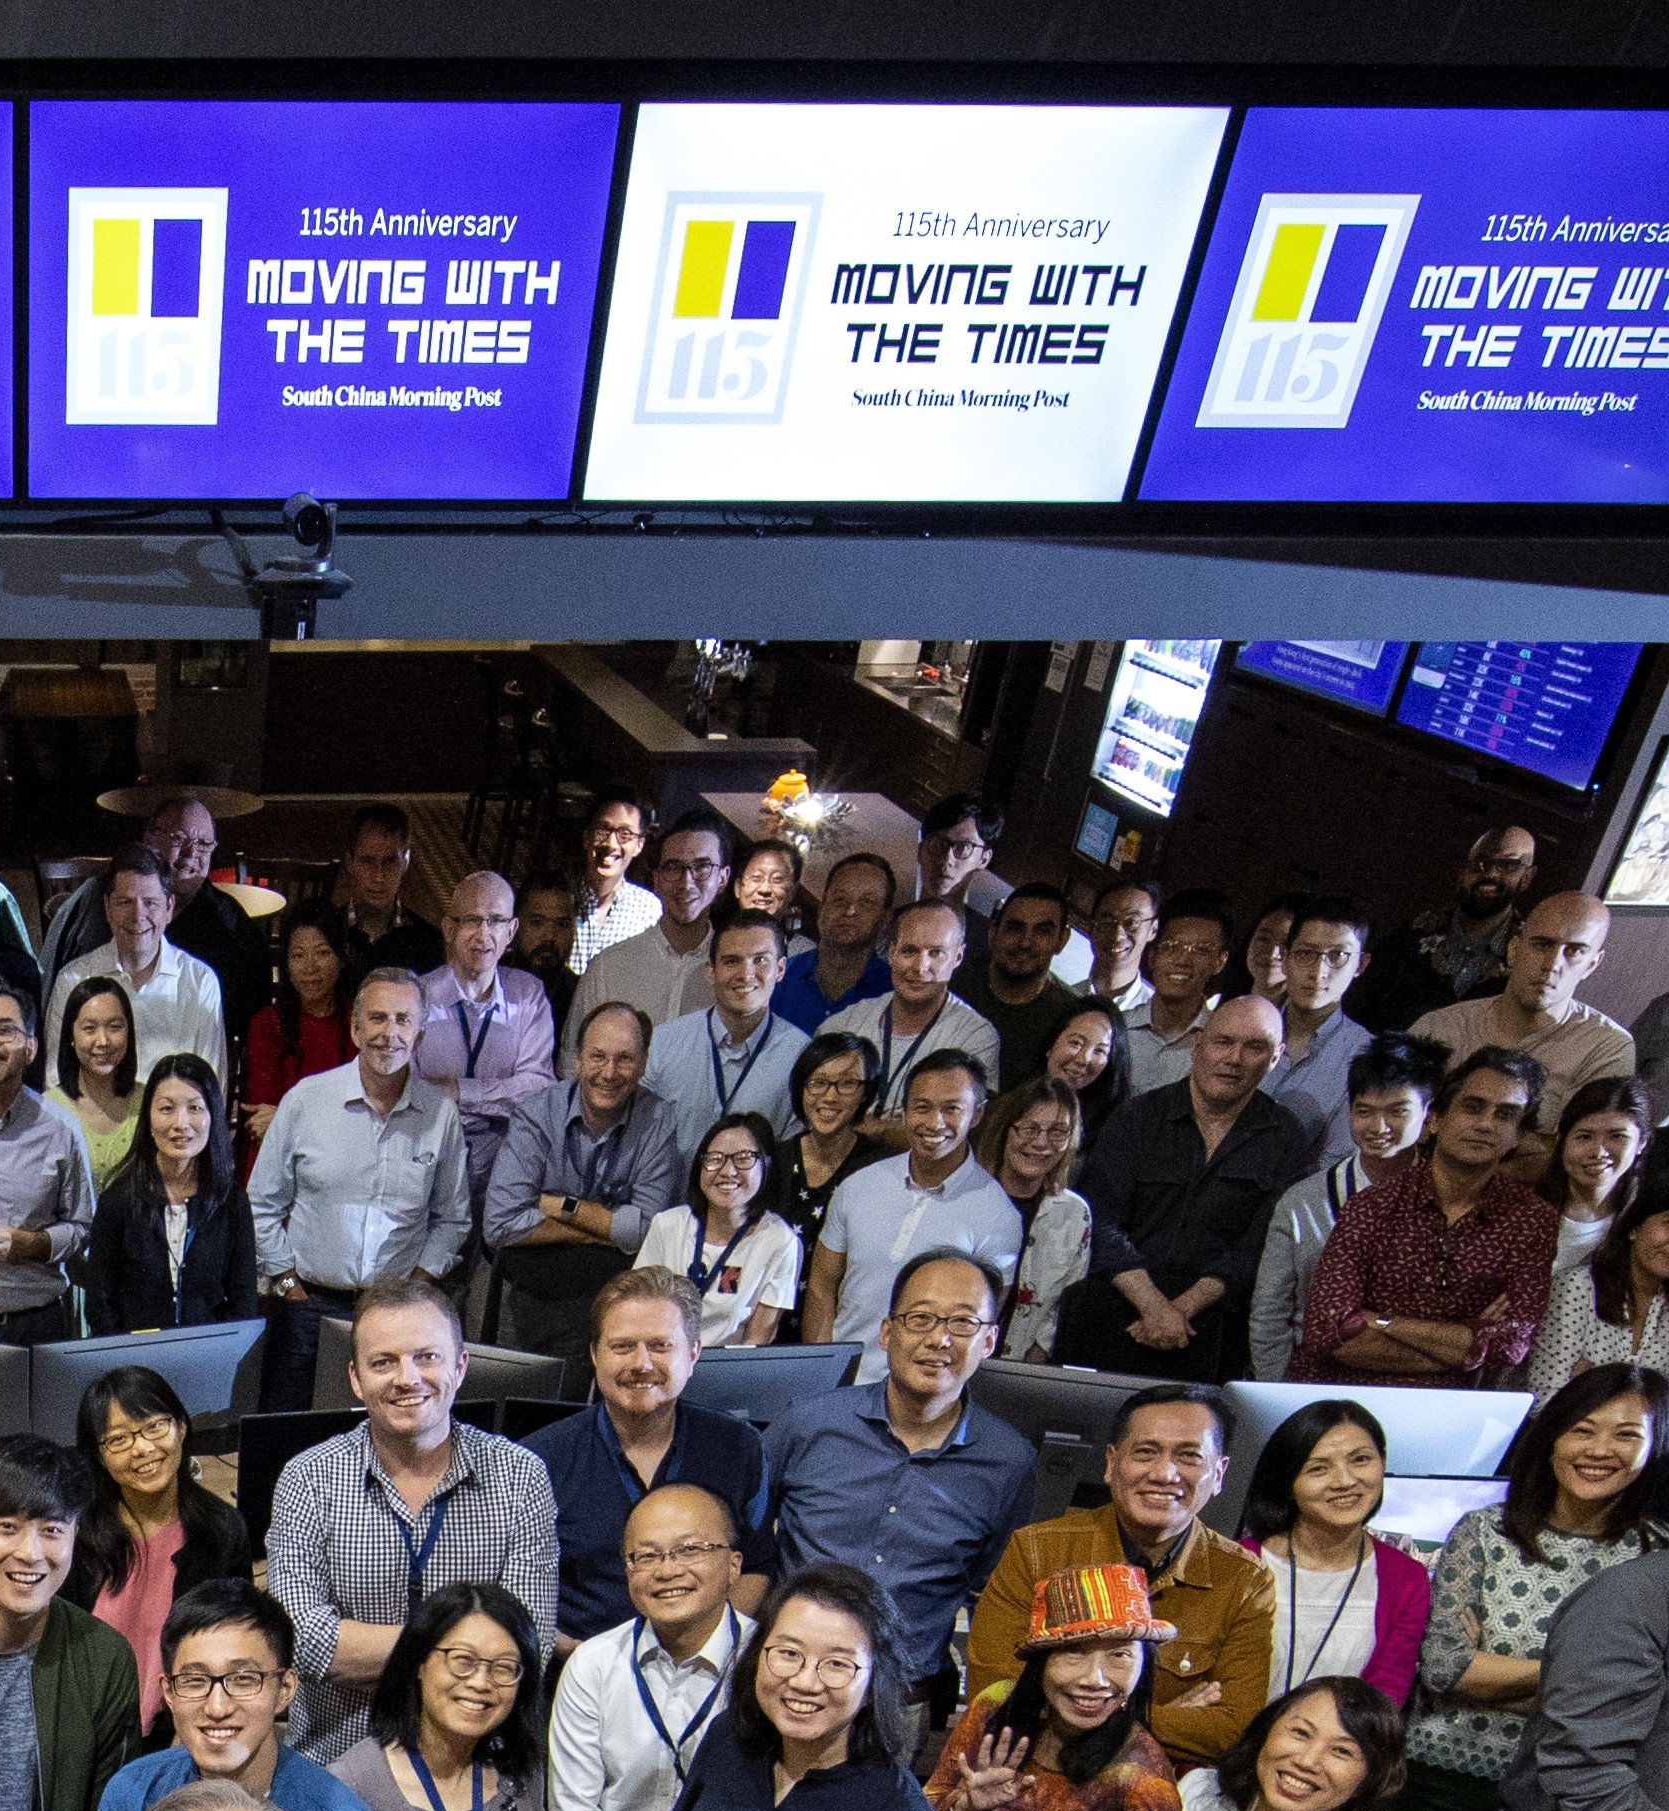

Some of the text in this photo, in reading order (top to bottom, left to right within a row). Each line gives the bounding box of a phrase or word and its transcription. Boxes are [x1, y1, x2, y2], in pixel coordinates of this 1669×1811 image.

[300, 208, 517, 242] 115th Anniversary
[894, 212, 1110, 245] 115th Anniversary
[1482, 215, 1547, 241] 115th
[247, 260, 560, 304] MOVING WITH
[831, 264, 1146, 306] MOVING WITH
[1410, 266, 1598, 309] MOVING
[267, 320, 531, 363] THE TIMES
[847, 324, 1109, 364] THE TIMES
[1422, 325, 1521, 367] THE
[283, 385, 501, 411] South China Morning Post
[853, 389, 1069, 411] South China Morning Post
[1417, 391, 1637, 415] South China Morning Post
